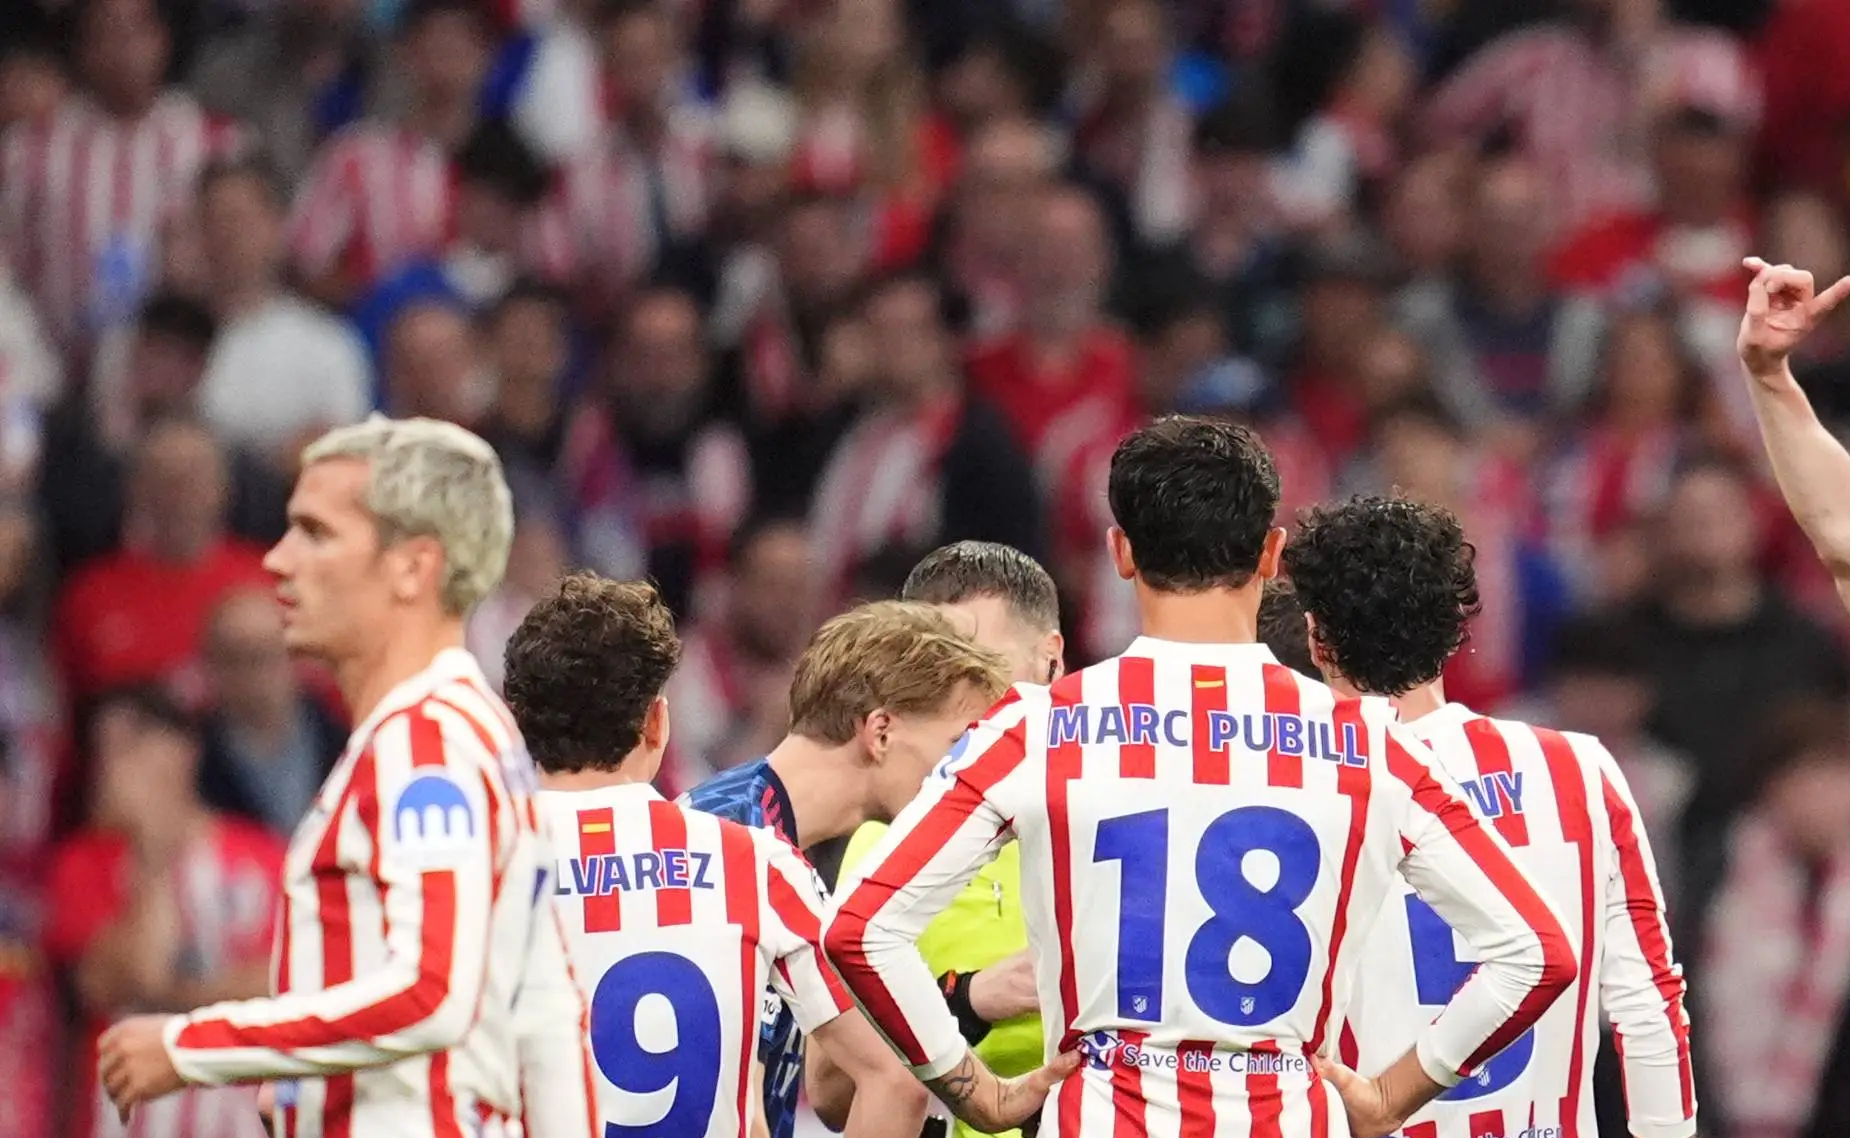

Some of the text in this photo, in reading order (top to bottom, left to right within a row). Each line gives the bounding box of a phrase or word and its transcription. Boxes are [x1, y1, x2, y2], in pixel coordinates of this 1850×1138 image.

[1049, 704, 1368, 768] MARC PUBILL
[554, 849, 716, 897] LVAREZ
[1093, 805, 1322, 1027] 18
[1121, 1043, 1179, 1070] Save
[1183, 1050, 1222, 1073] the
